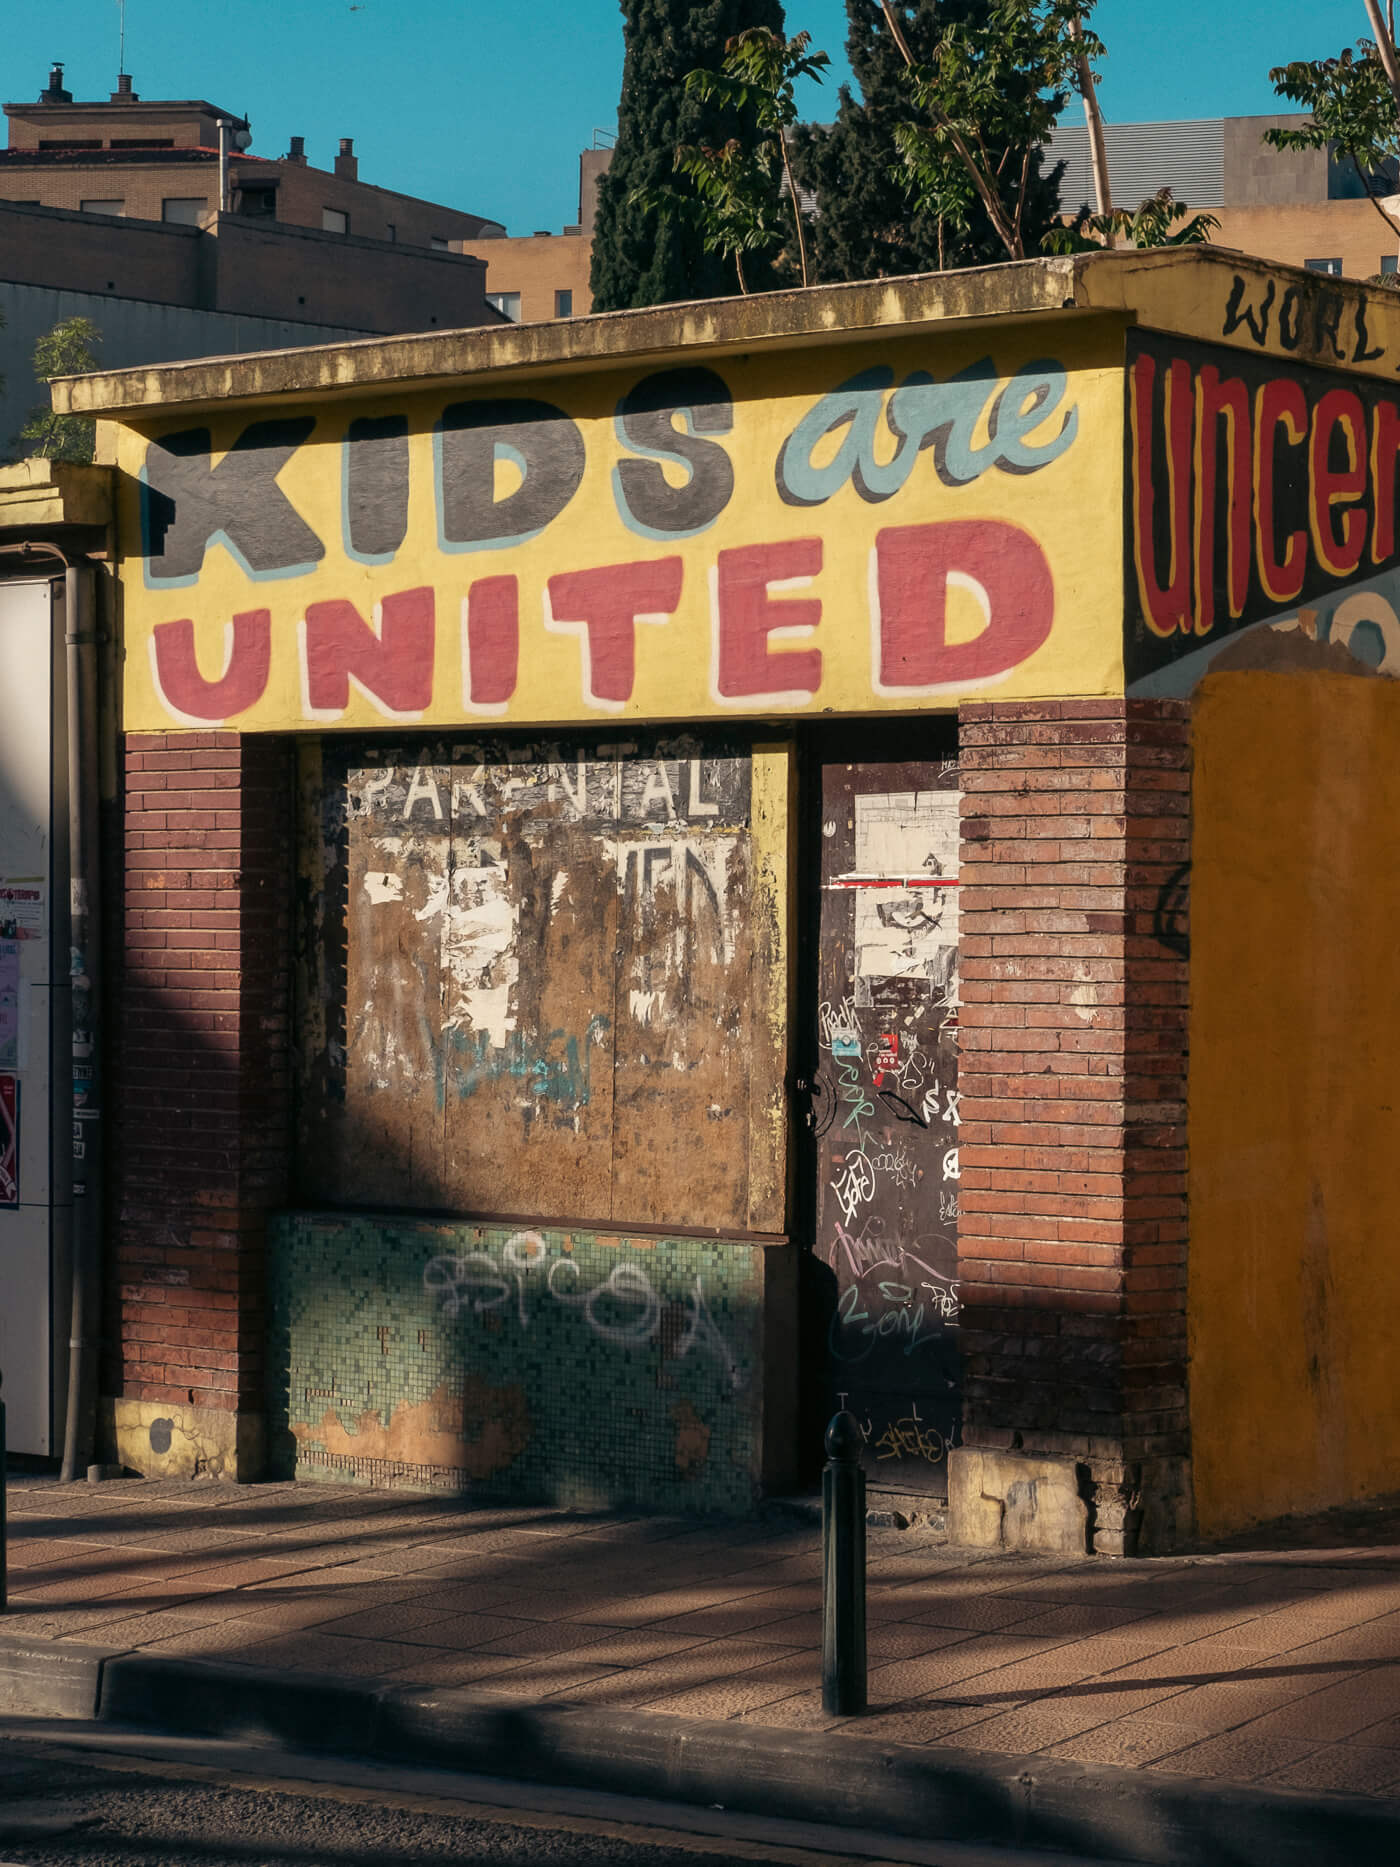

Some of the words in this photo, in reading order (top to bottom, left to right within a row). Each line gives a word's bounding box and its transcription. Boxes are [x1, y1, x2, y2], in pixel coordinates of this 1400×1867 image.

[140, 366, 735, 589] KIDS
[775, 355, 1079, 507] are
[149, 519, 1055, 728] UNITED
